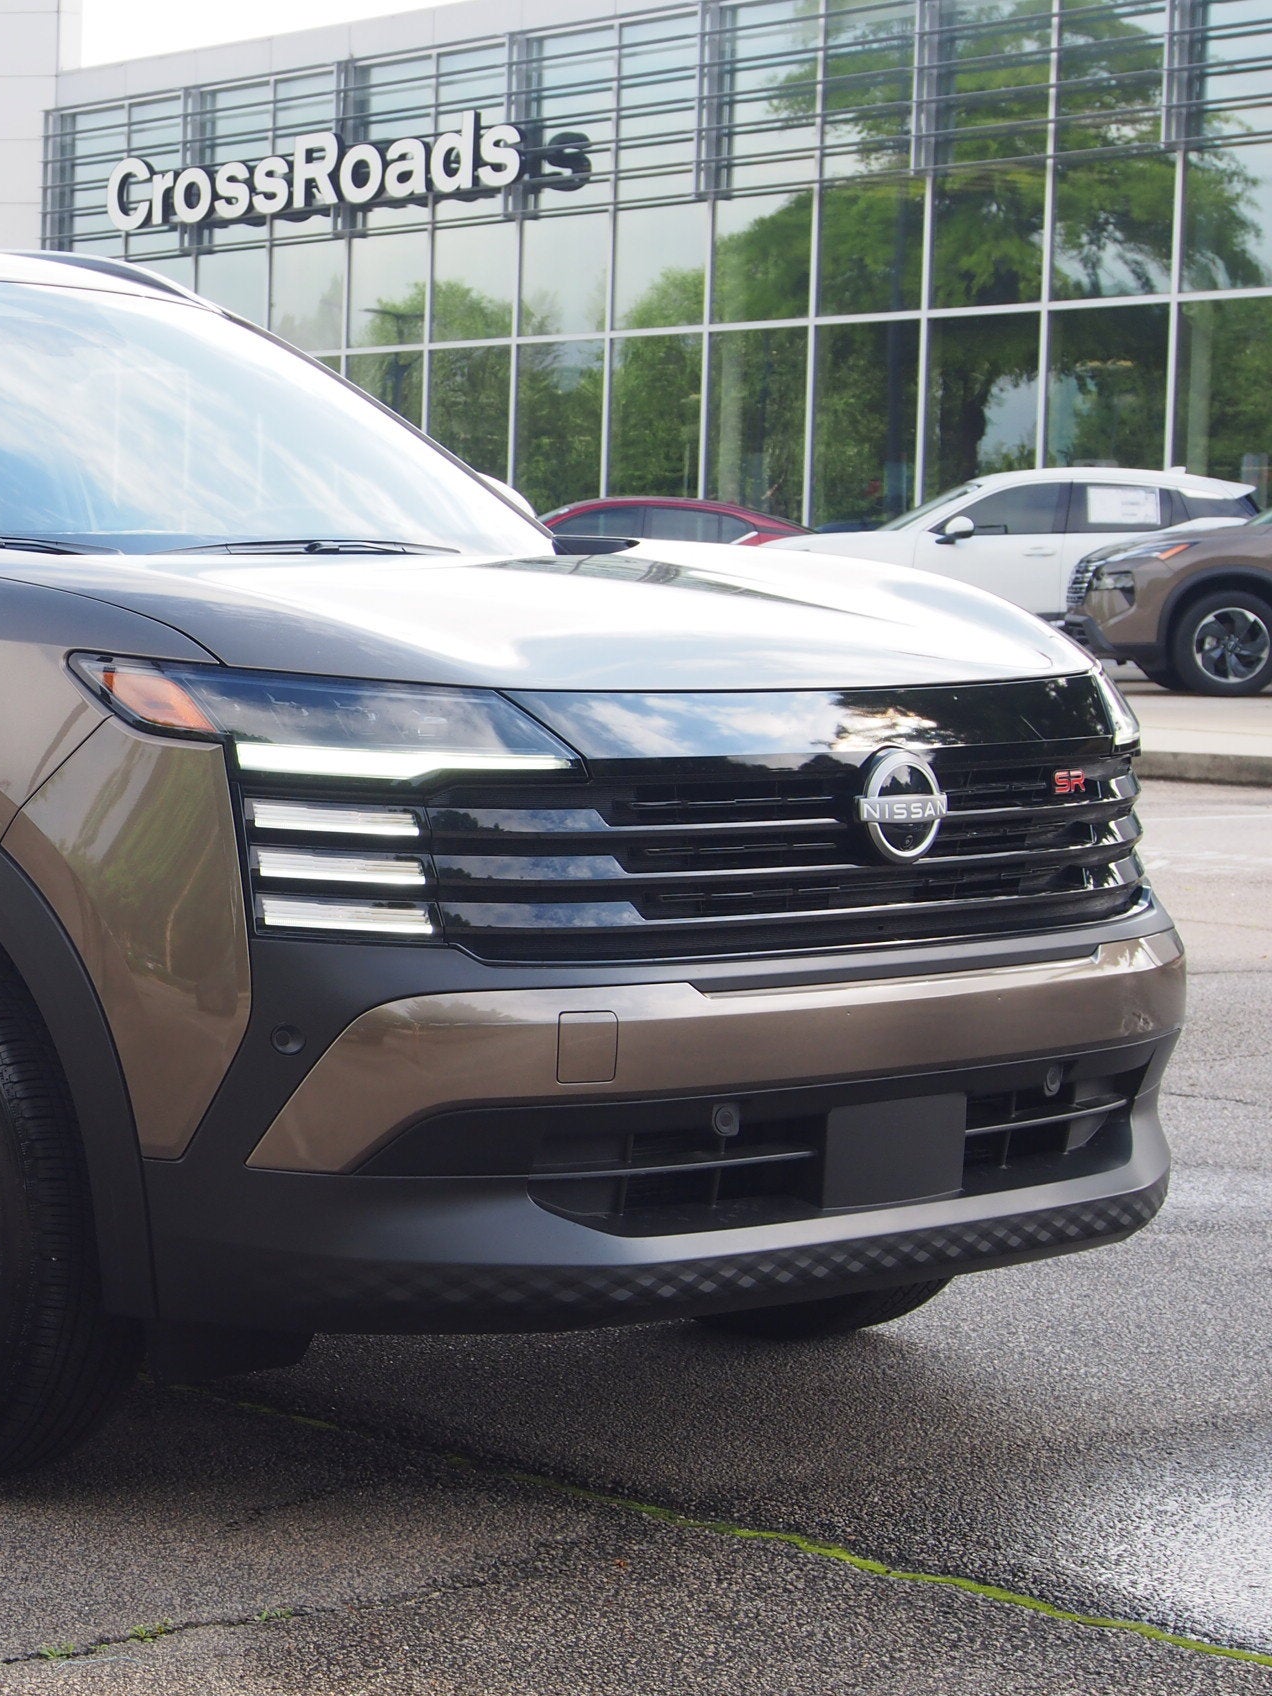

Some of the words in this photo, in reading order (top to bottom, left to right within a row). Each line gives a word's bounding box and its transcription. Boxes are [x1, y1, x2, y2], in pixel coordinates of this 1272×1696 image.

[107, 109, 524, 230] CrossRoads
[1054, 769, 1085, 794] SR
[862, 800, 947, 820] NISSAN
